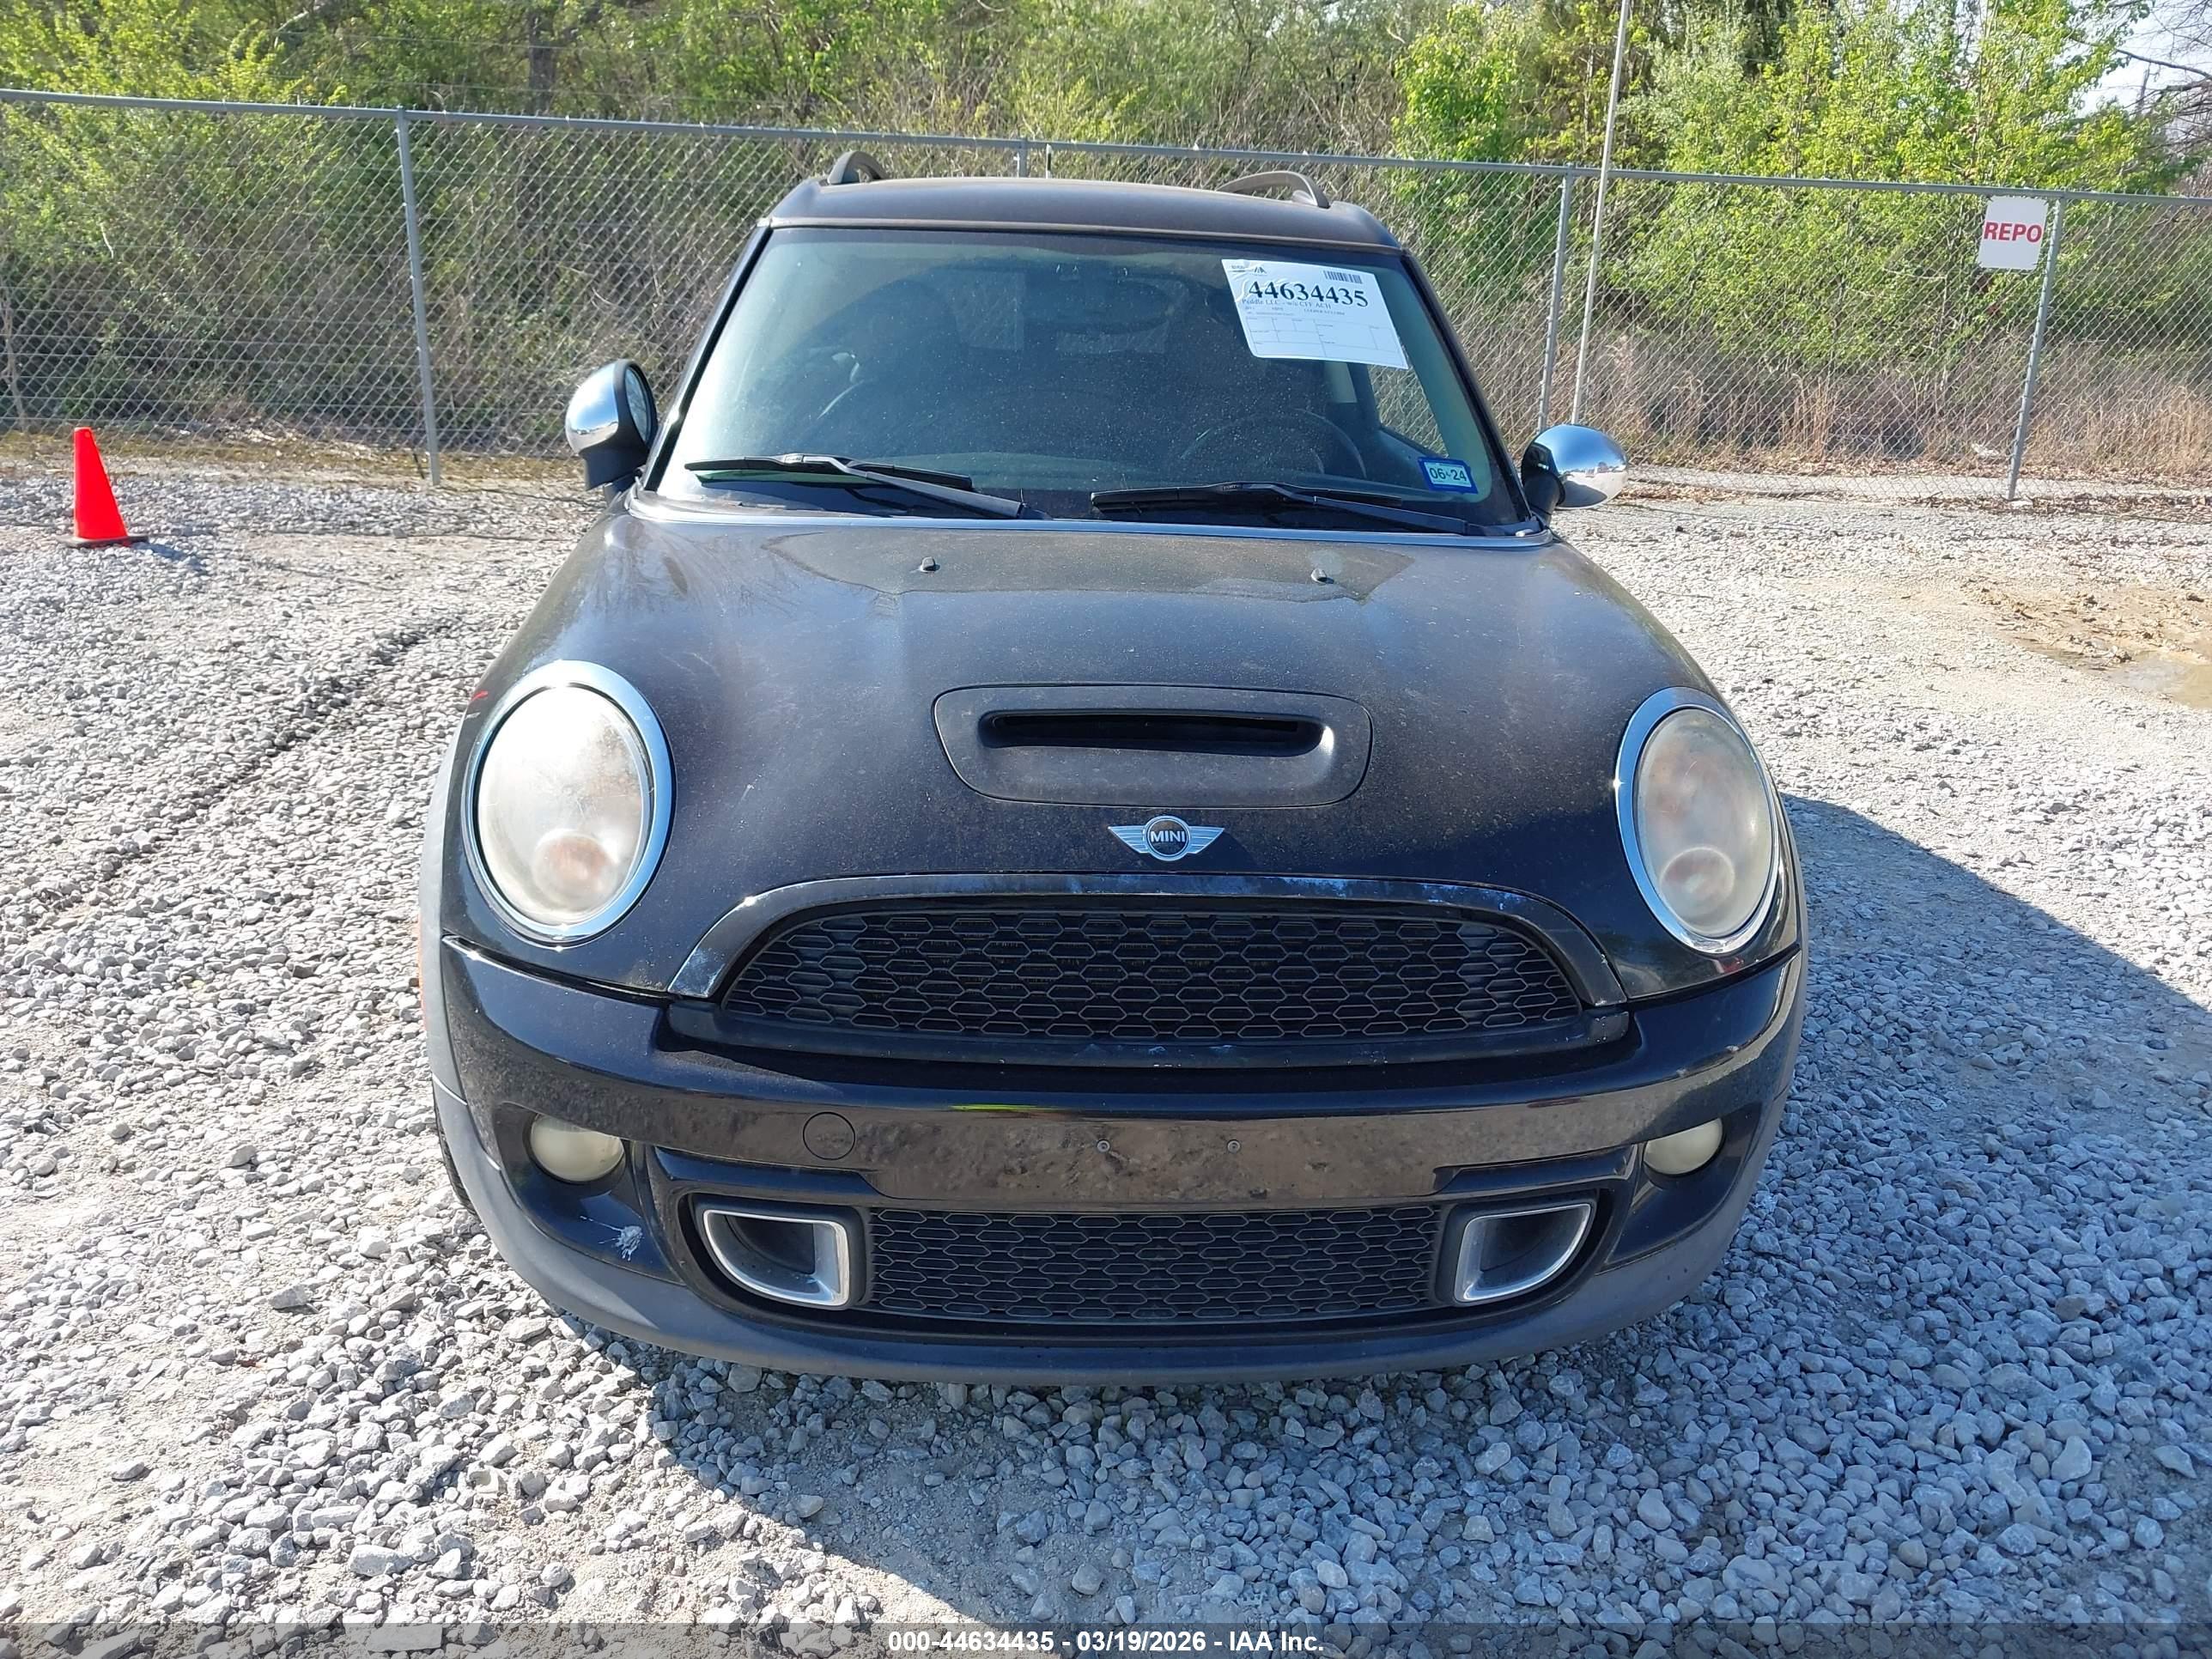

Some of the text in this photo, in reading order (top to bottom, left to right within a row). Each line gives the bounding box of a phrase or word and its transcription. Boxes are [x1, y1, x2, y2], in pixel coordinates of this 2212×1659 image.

[1984, 222, 2042, 243] REPO
[1249, 281, 1369, 307] 44634435
[1151, 830, 1186, 842] MINI
